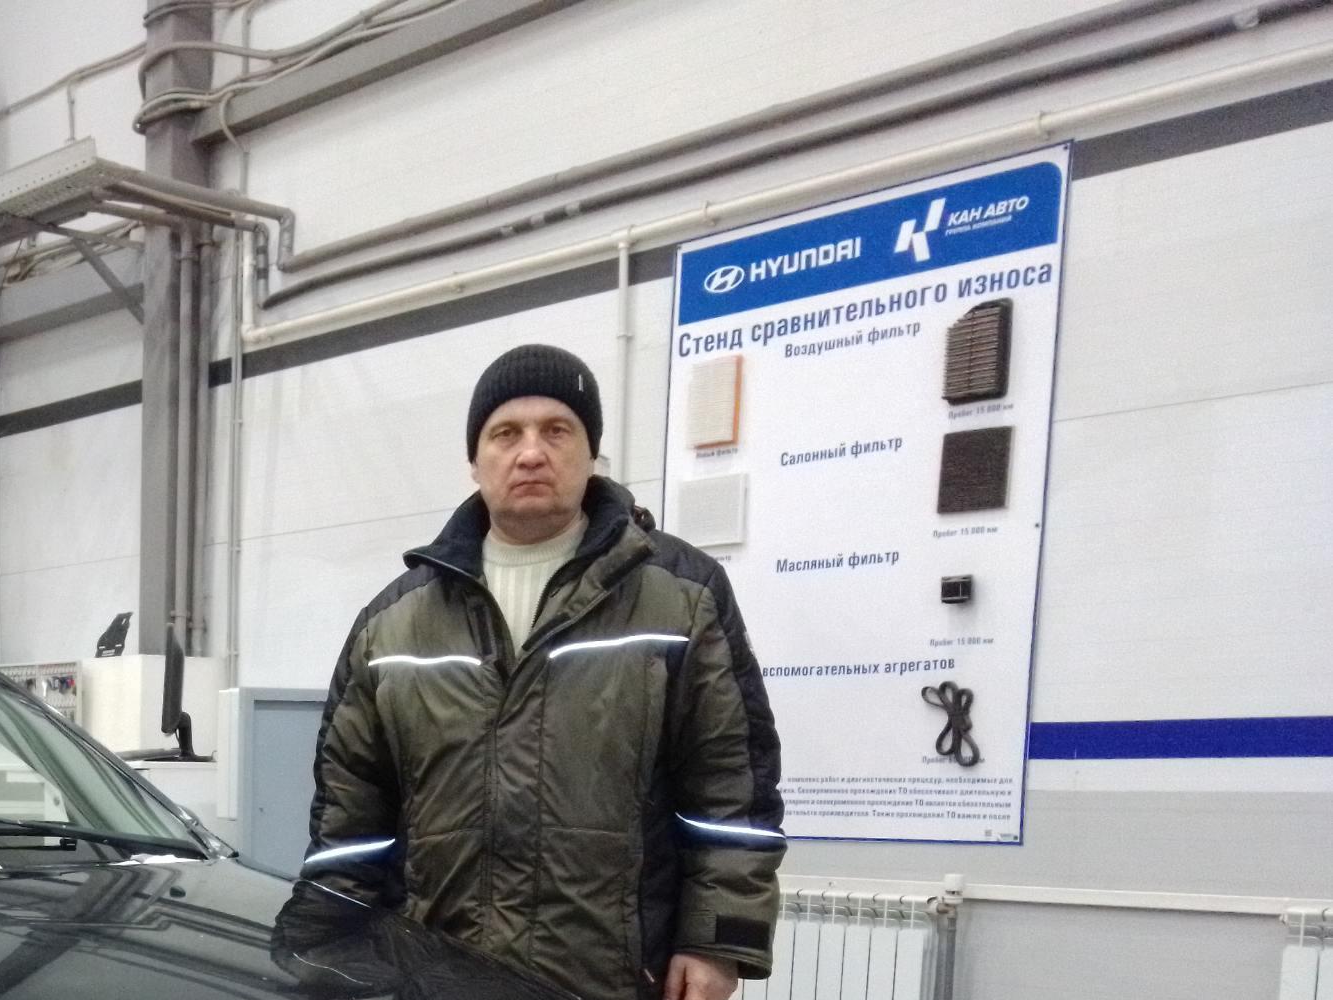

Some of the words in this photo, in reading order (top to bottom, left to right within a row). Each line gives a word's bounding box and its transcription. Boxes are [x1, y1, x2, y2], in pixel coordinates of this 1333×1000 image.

[948, 206, 983, 226] КАН
[983, 195, 1029, 216] АВТО
[750, 237, 862, 282] HYUNDAI
[679, 328, 743, 357] Стенд
[751, 283, 947, 346] сравнительного
[958, 263, 1053, 298] износа
[784, 330, 863, 358] Воздушный
[868, 322, 921, 345] фильтр
[780, 442, 846, 466] Салонный
[851, 438, 903, 458] фильтр
[776, 552, 844, 573] Масляный
[848, 551, 900, 570] фильтр
[763, 662, 880, 677] вспомогательных
[884, 657, 955, 676] агрегатов
